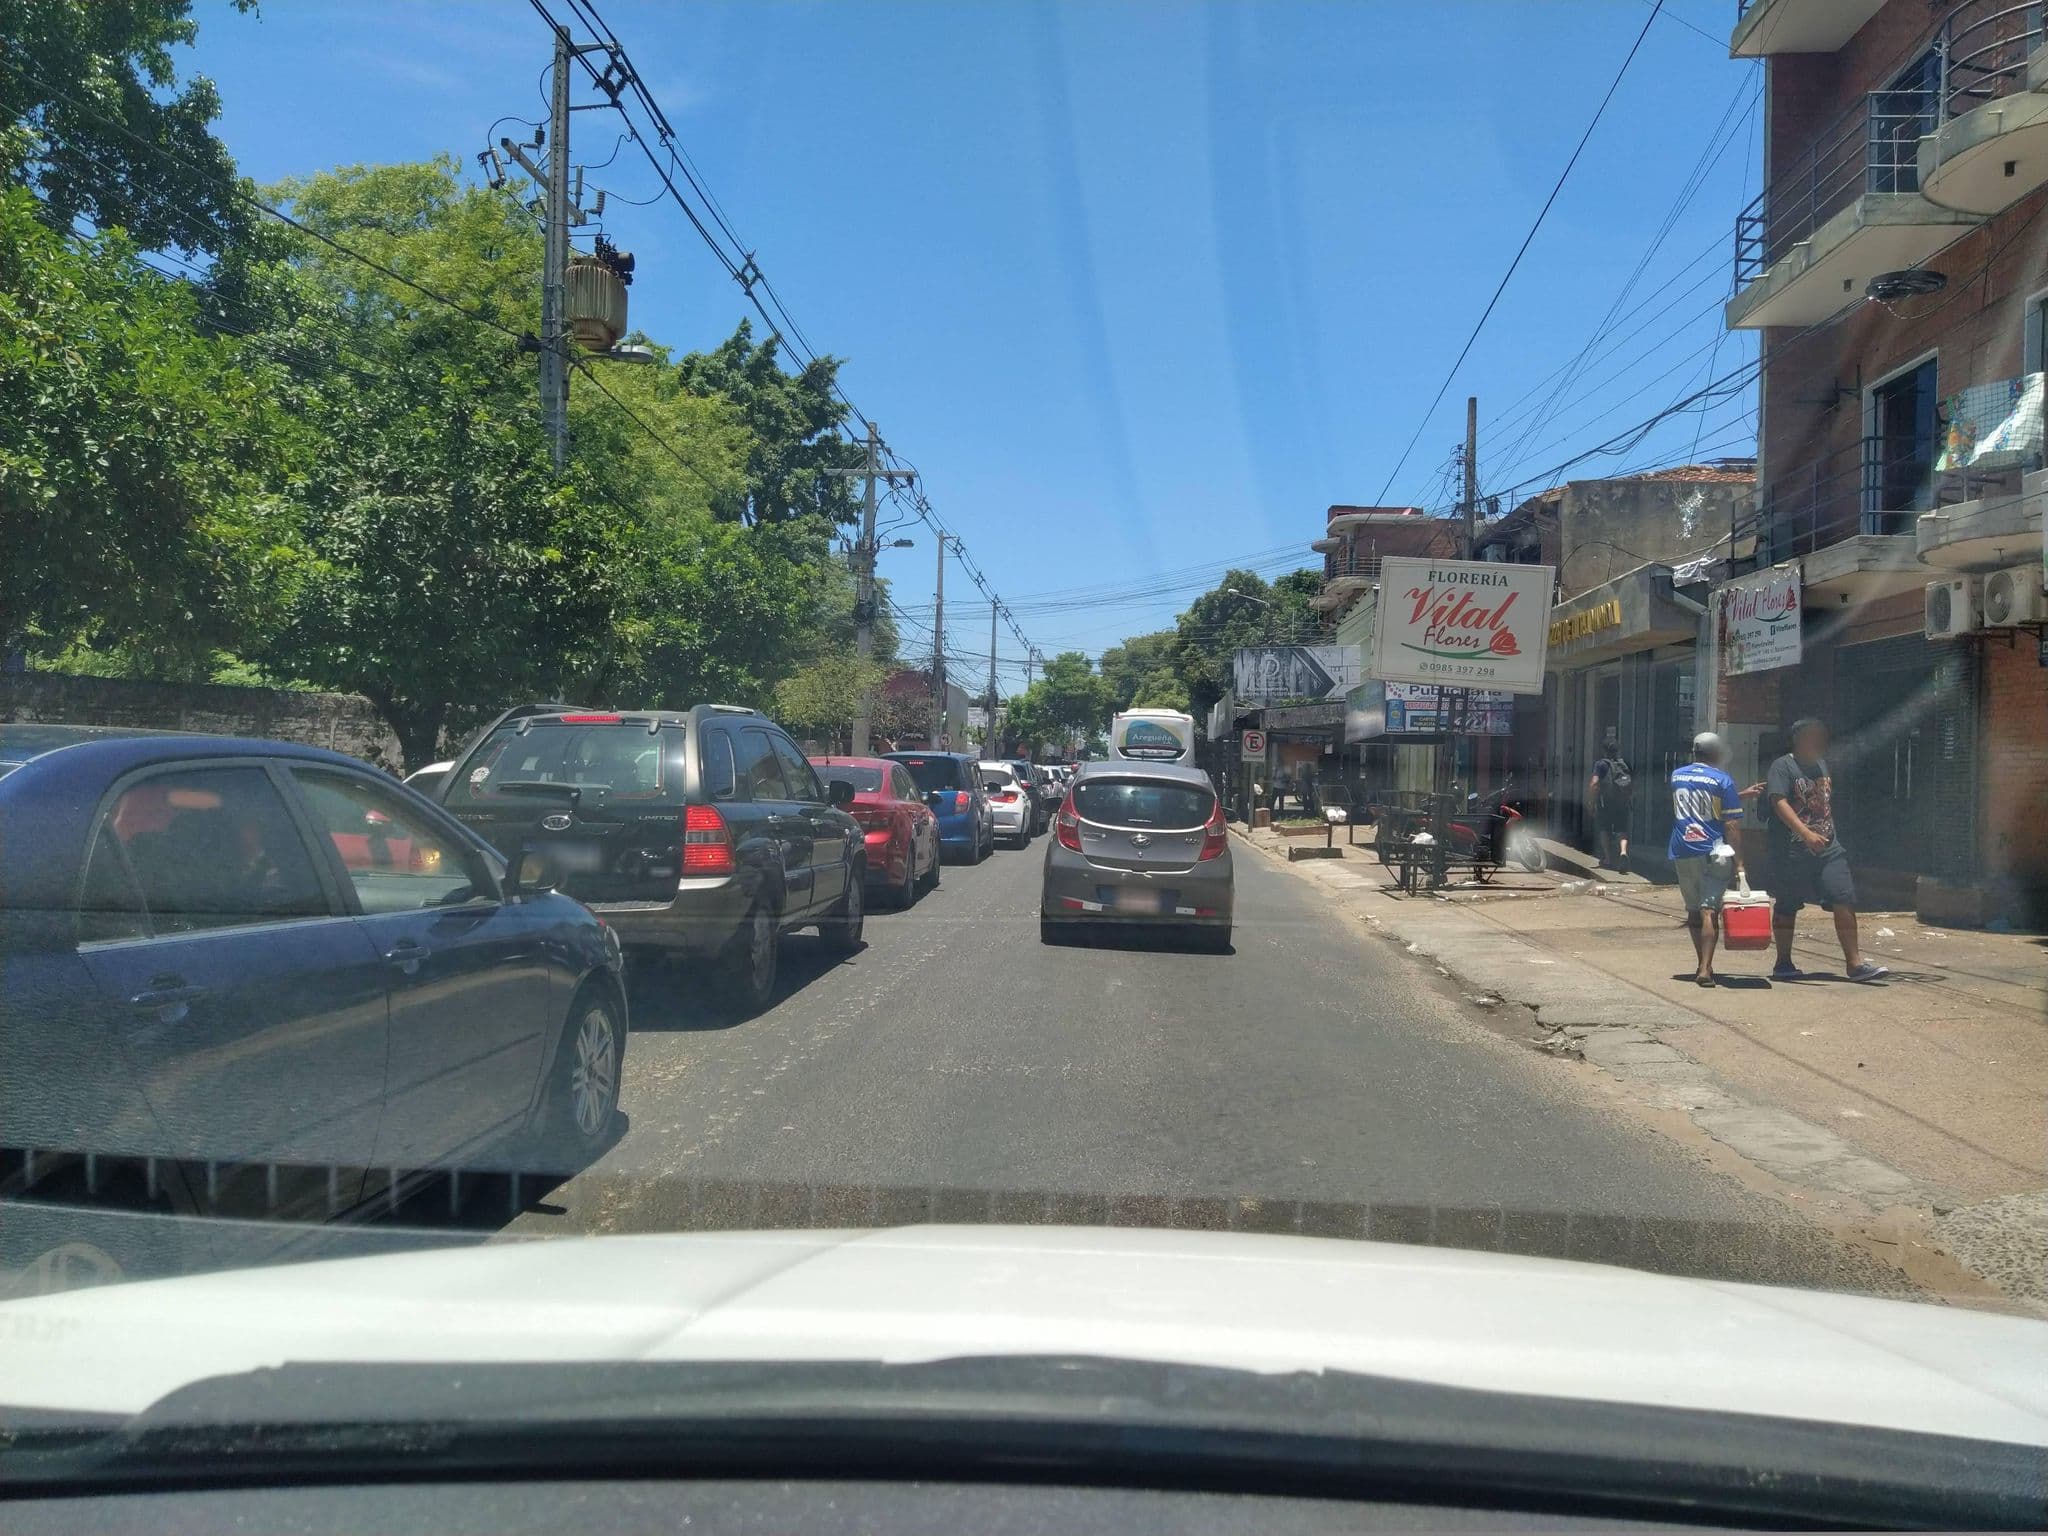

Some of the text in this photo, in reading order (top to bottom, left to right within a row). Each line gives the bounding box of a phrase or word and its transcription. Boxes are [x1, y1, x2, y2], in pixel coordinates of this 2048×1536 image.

[1428, 571, 1508, 586] FLORERÍA
[1403, 586, 1519, 630] Vital
[1424, 625, 1480, 648] Flores
[1430, 662, 1495, 676] 0985 397 298
[1132, 733, 1173, 742] Aregueña
